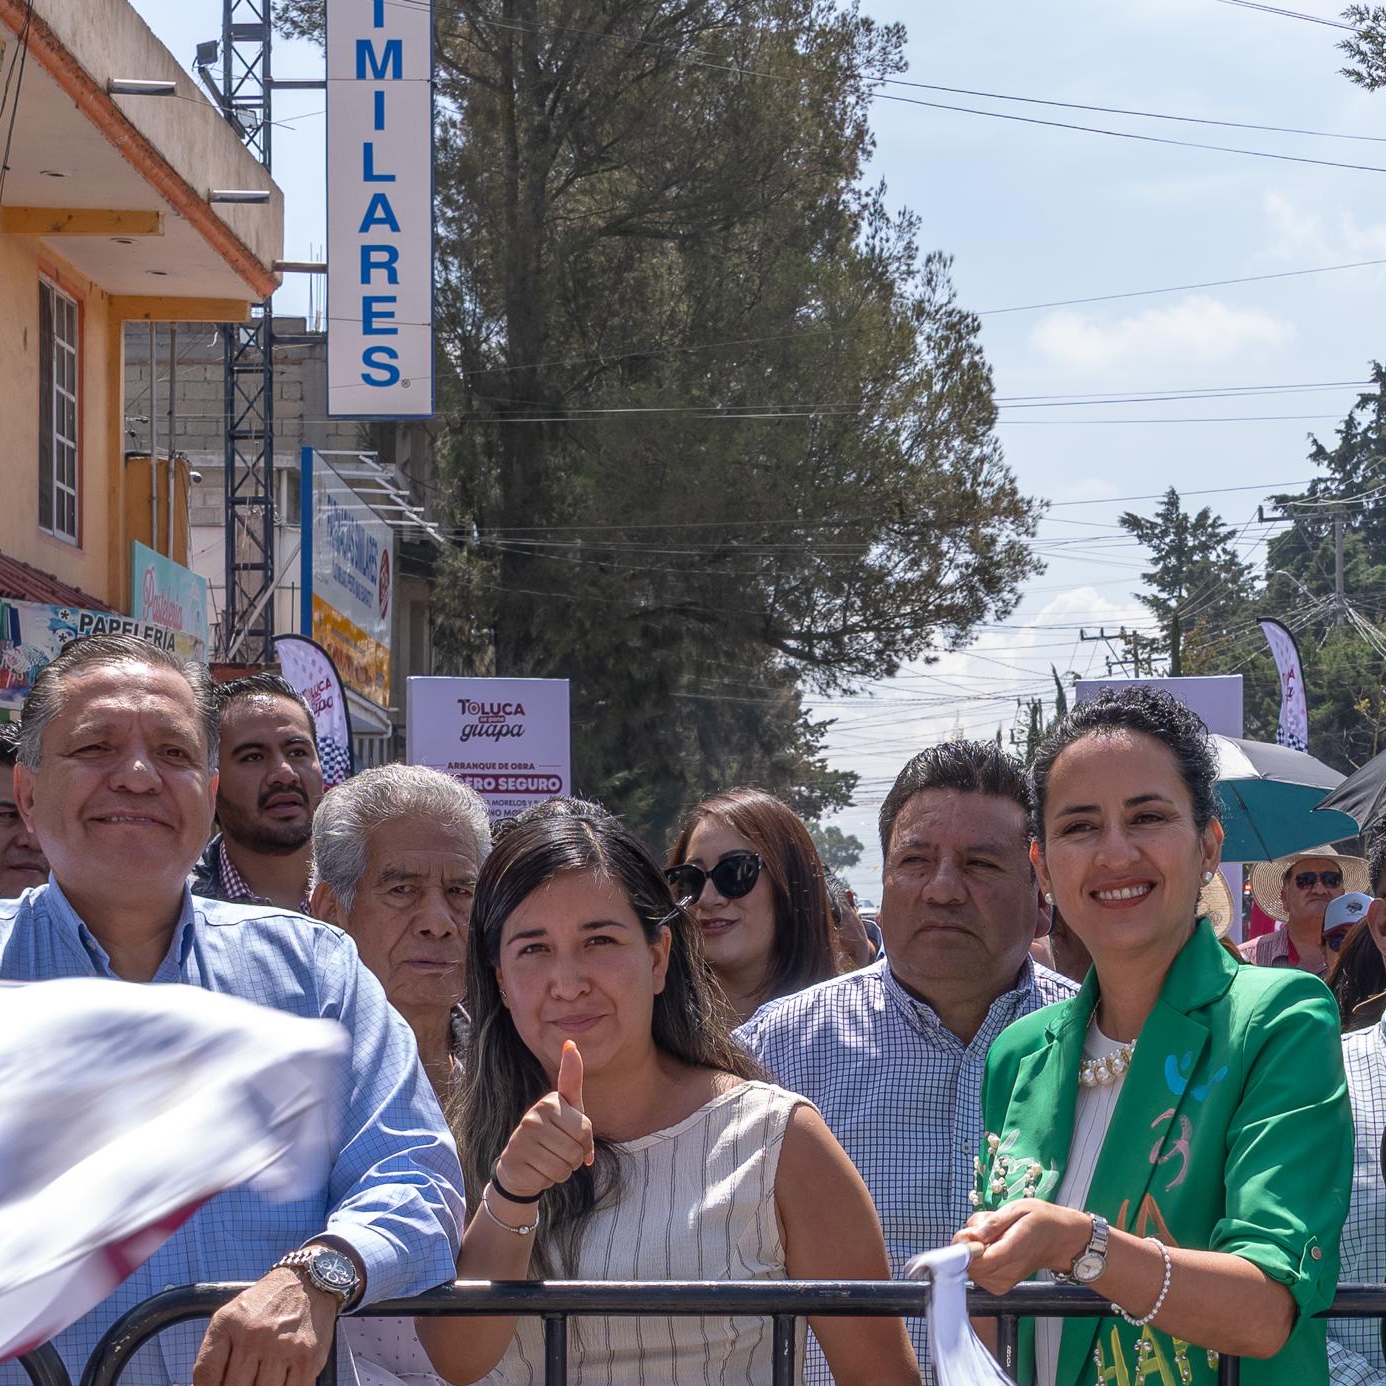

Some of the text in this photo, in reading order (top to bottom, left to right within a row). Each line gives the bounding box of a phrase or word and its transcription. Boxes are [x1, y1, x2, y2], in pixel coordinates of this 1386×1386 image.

[457, 698, 526, 716] TOLUCA
[459, 723, 526, 742] guapa
[447, 761, 535, 770] ARRANQUE DE OBRA
[498, 777, 561, 791] SEGURO
